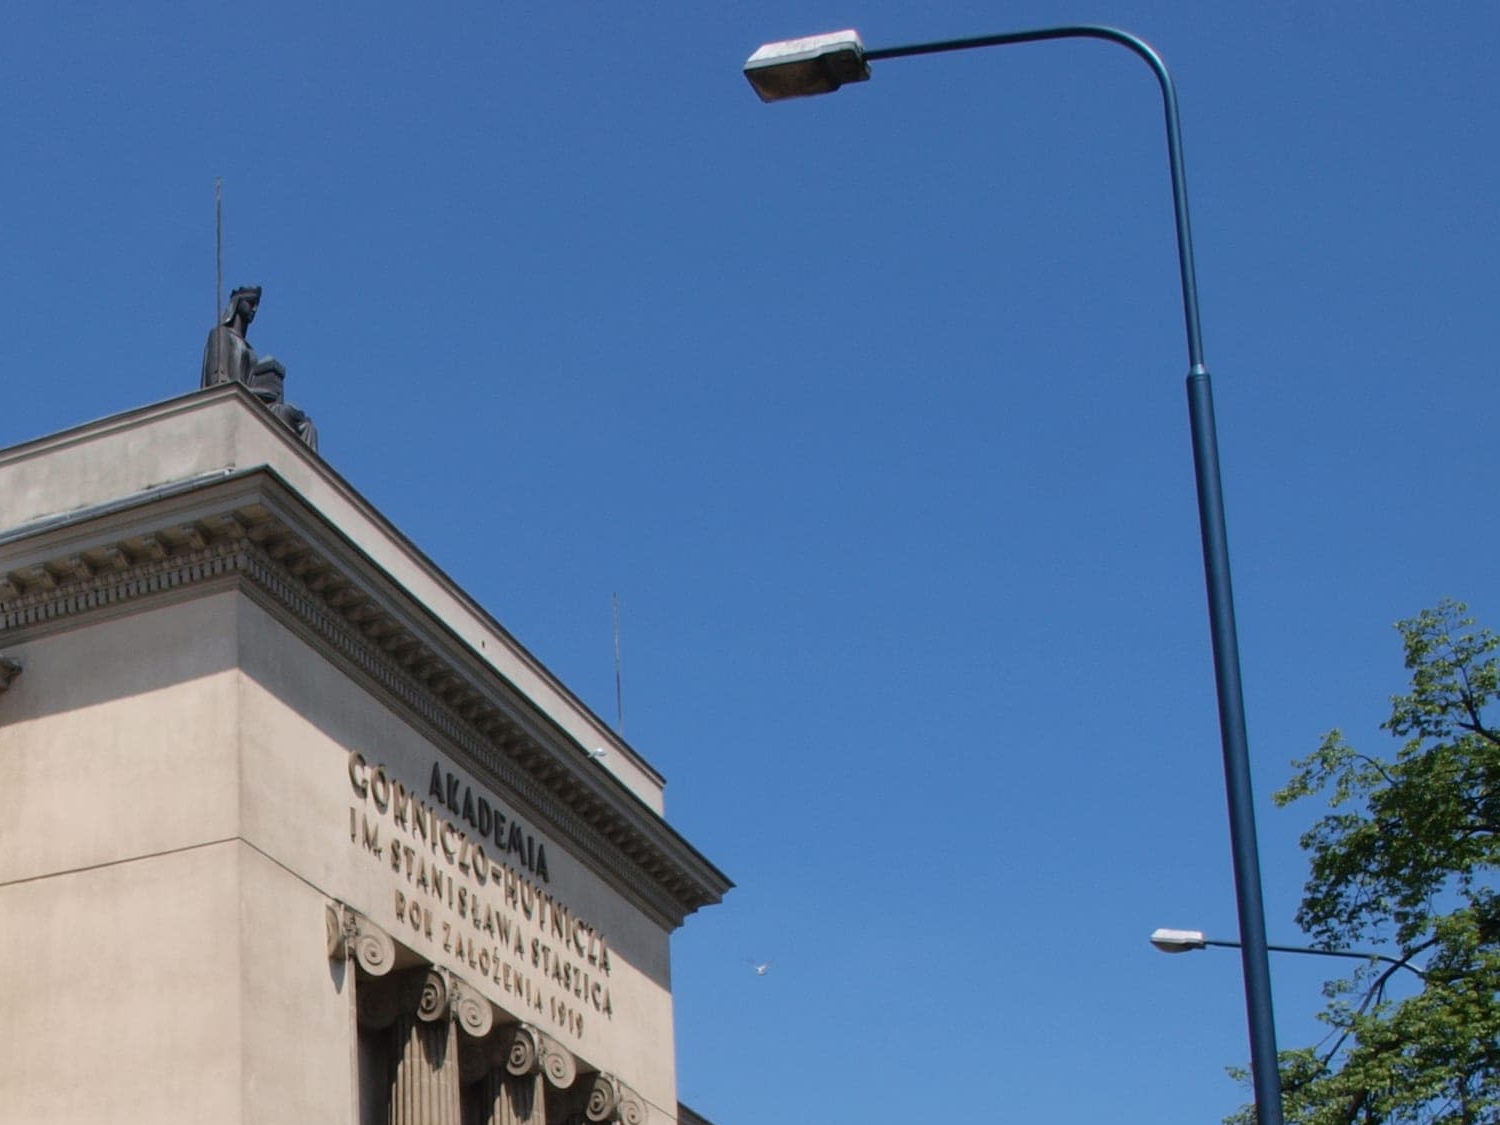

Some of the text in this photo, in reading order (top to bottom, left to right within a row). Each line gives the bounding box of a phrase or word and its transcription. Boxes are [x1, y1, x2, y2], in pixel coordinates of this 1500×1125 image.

[429, 761, 549, 883] AKADEMIA
[350, 807, 382, 861] IM.
[531, 938, 612, 1021] STASZICA
[395, 889, 434, 943] ROK
[550, 996, 584, 1040] 1919
